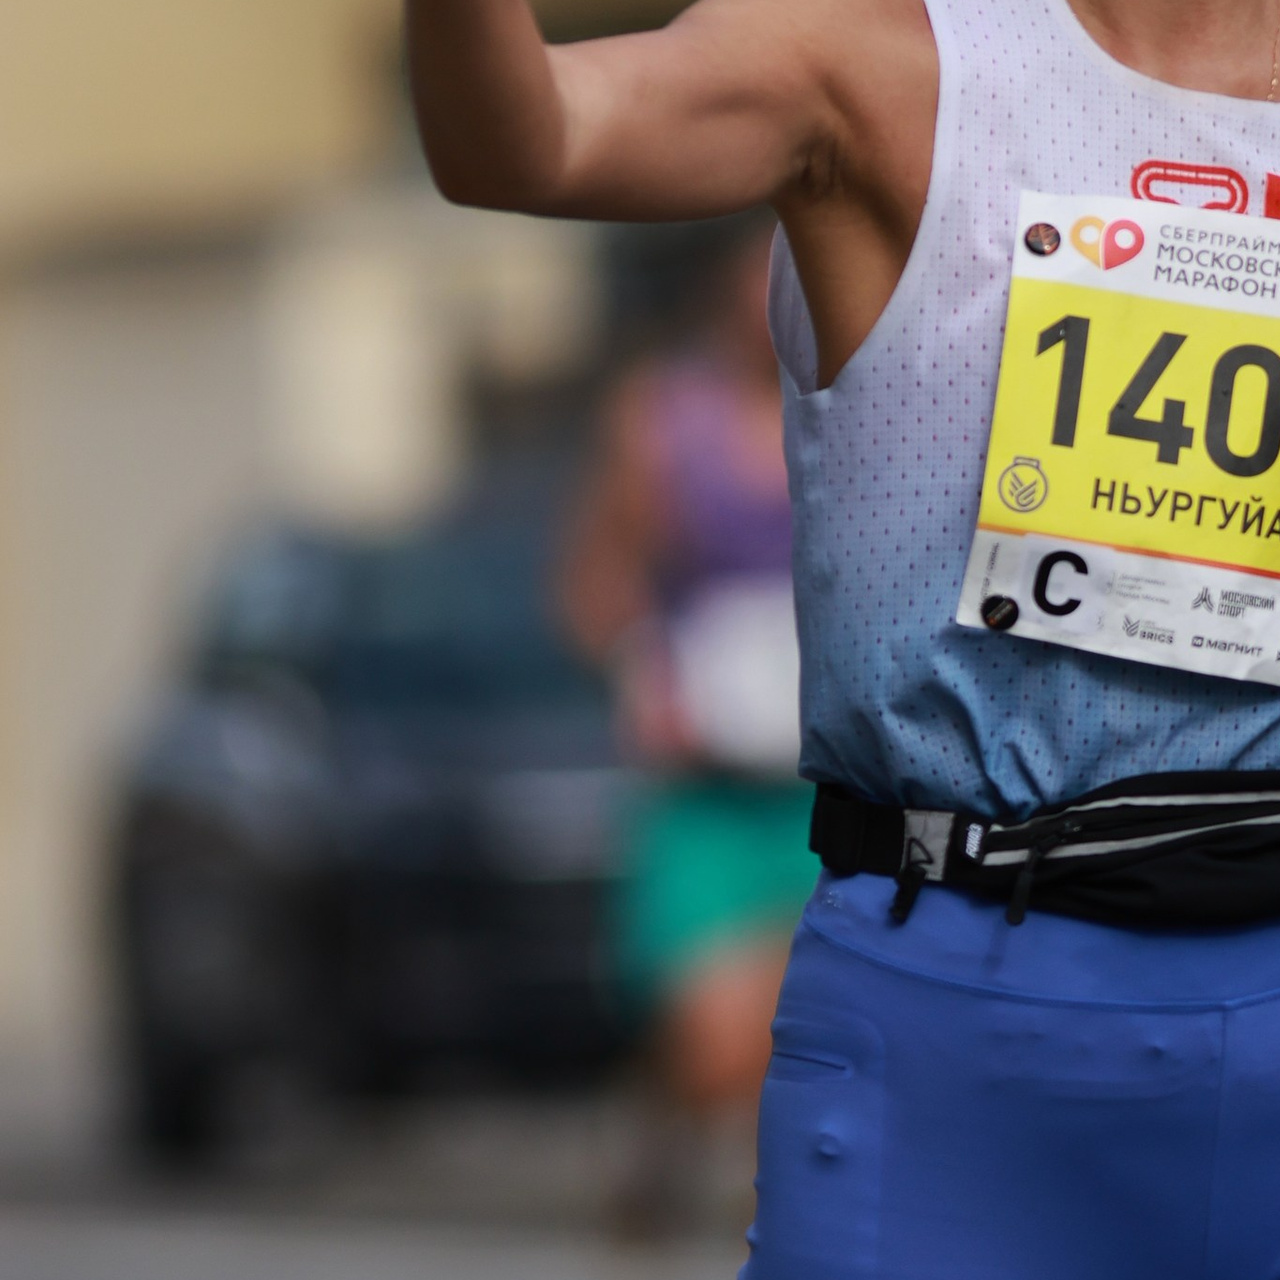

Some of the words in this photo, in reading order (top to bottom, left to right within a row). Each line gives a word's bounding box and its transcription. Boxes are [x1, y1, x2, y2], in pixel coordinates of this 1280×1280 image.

[1154, 265, 1276, 298] МАРАФОН
[1221, 589, 1275, 610] МОСКОВСКИЙ
[1217, 603, 1245, 618] СПОРТ
[1140, 630, 1174, 644] BRICS
